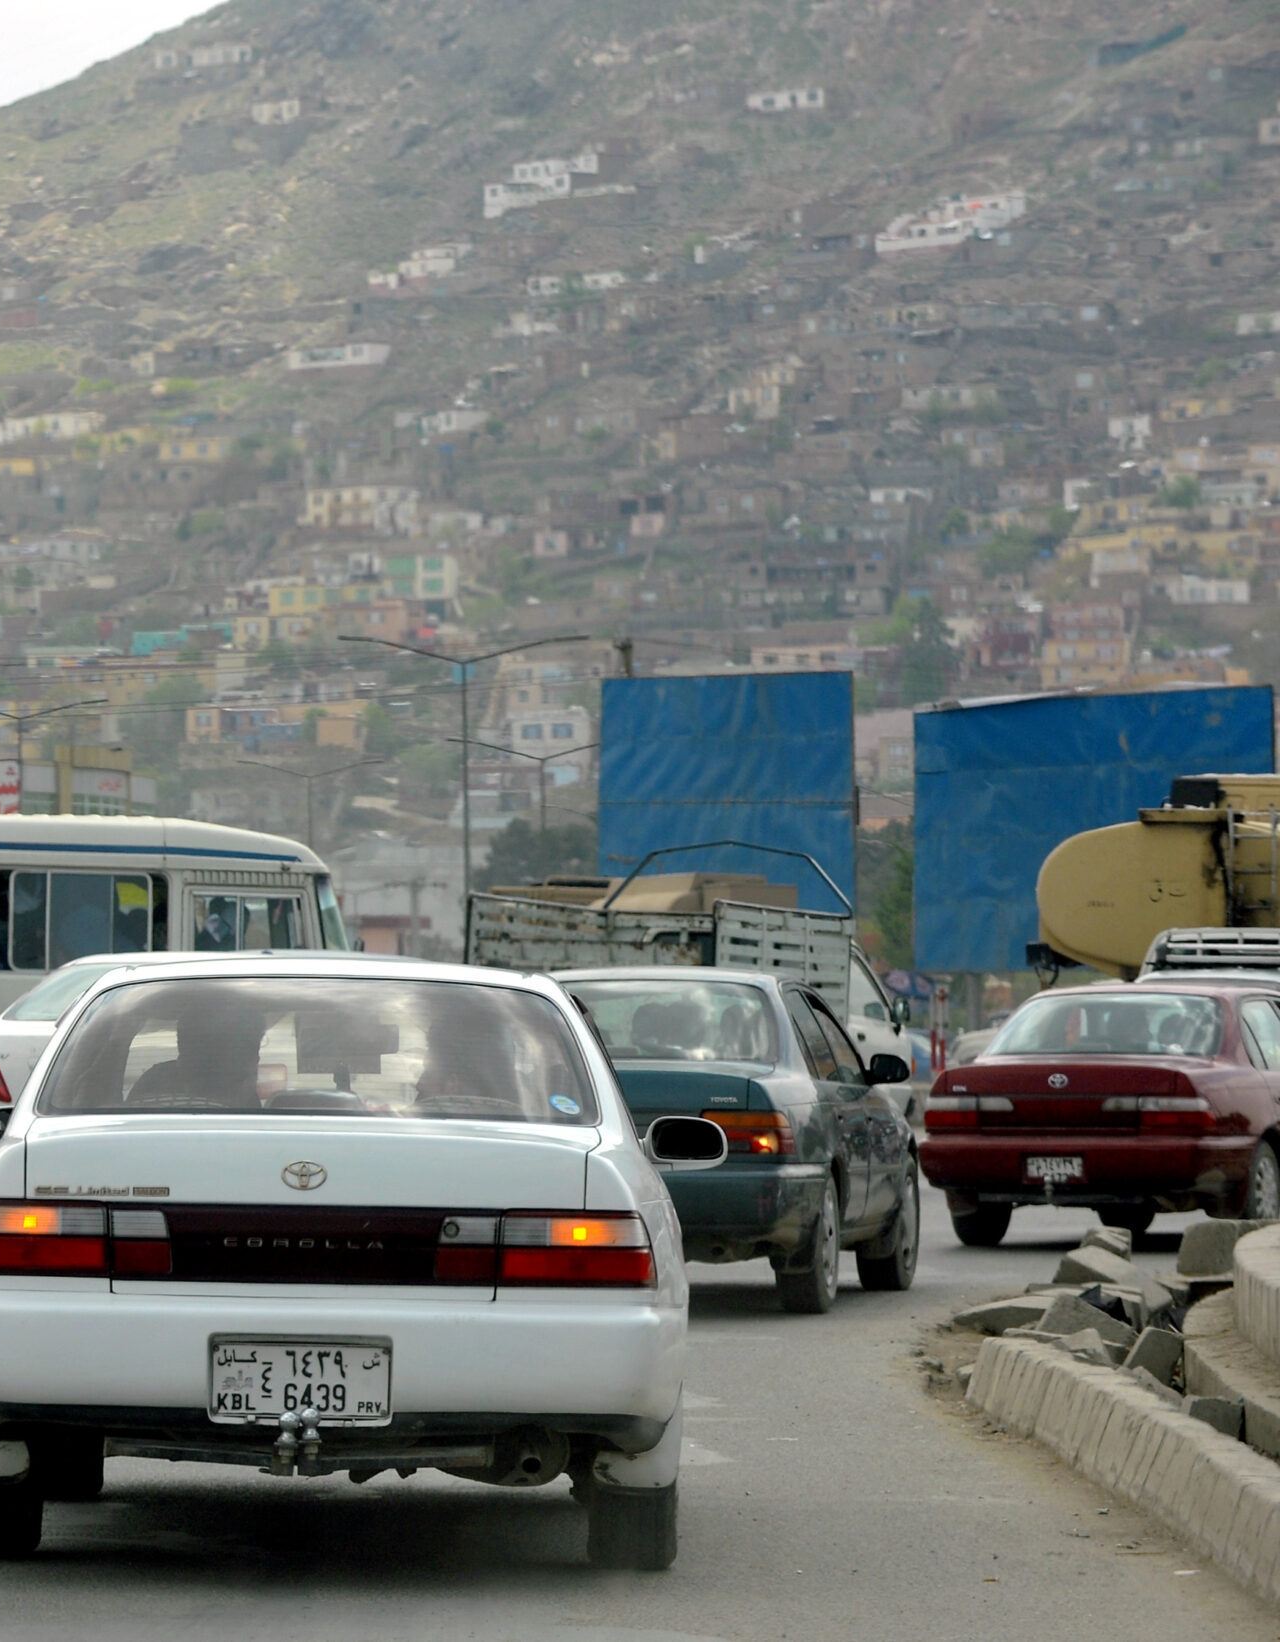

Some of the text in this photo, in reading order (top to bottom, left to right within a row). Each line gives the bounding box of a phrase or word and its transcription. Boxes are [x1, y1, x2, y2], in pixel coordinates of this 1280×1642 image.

[223, 1236, 384, 1249] COROLLA
[285, 1349, 347, 1379] ٦٤٣٩
[217, 1383, 382, 1413] KBL 6439 PRV
